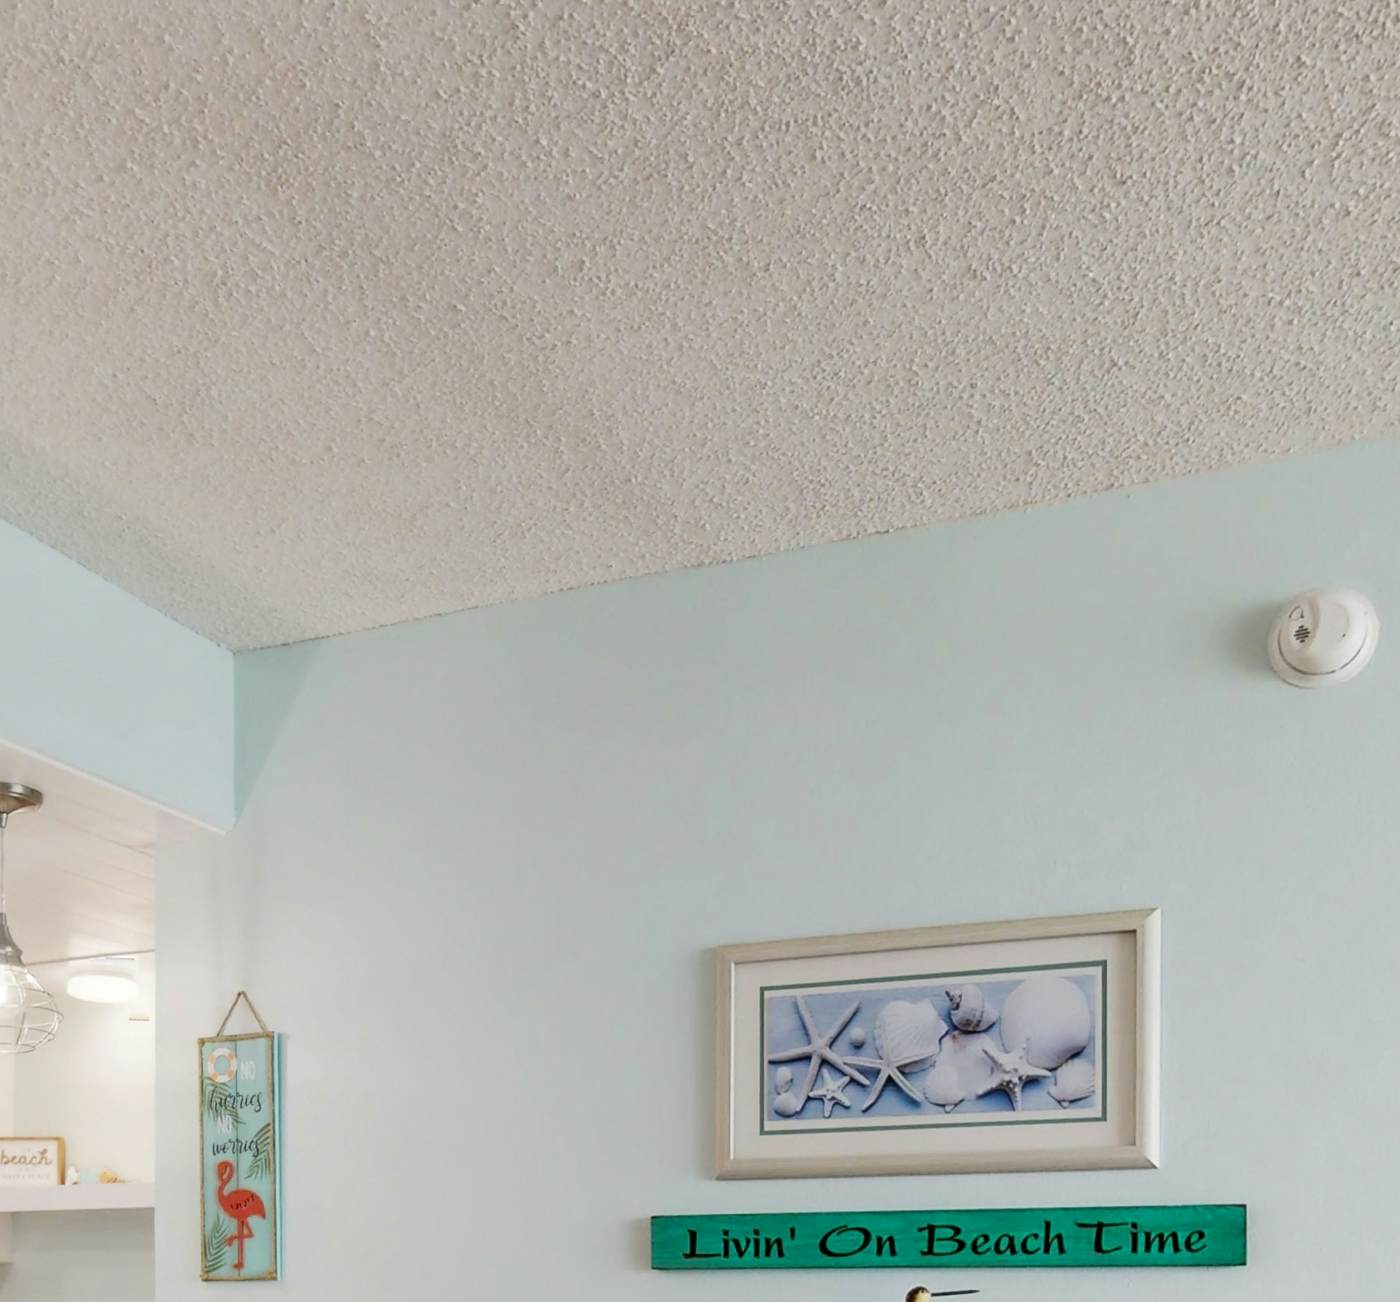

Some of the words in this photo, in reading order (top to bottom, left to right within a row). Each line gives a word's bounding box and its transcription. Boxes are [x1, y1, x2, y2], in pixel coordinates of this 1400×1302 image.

[240, 1060, 256, 1081] NO
[216, 1115, 233, 1136] NO
[0, 1148, 53, 1166] beach
[212, 1138, 260, 1158] worries
[682, 1226, 796, 1259] Livin'
[818, 1224, 898, 1258] On
[917, 1220, 1067, 1257] Beach
[1074, 1220, 1207, 1255] Time
